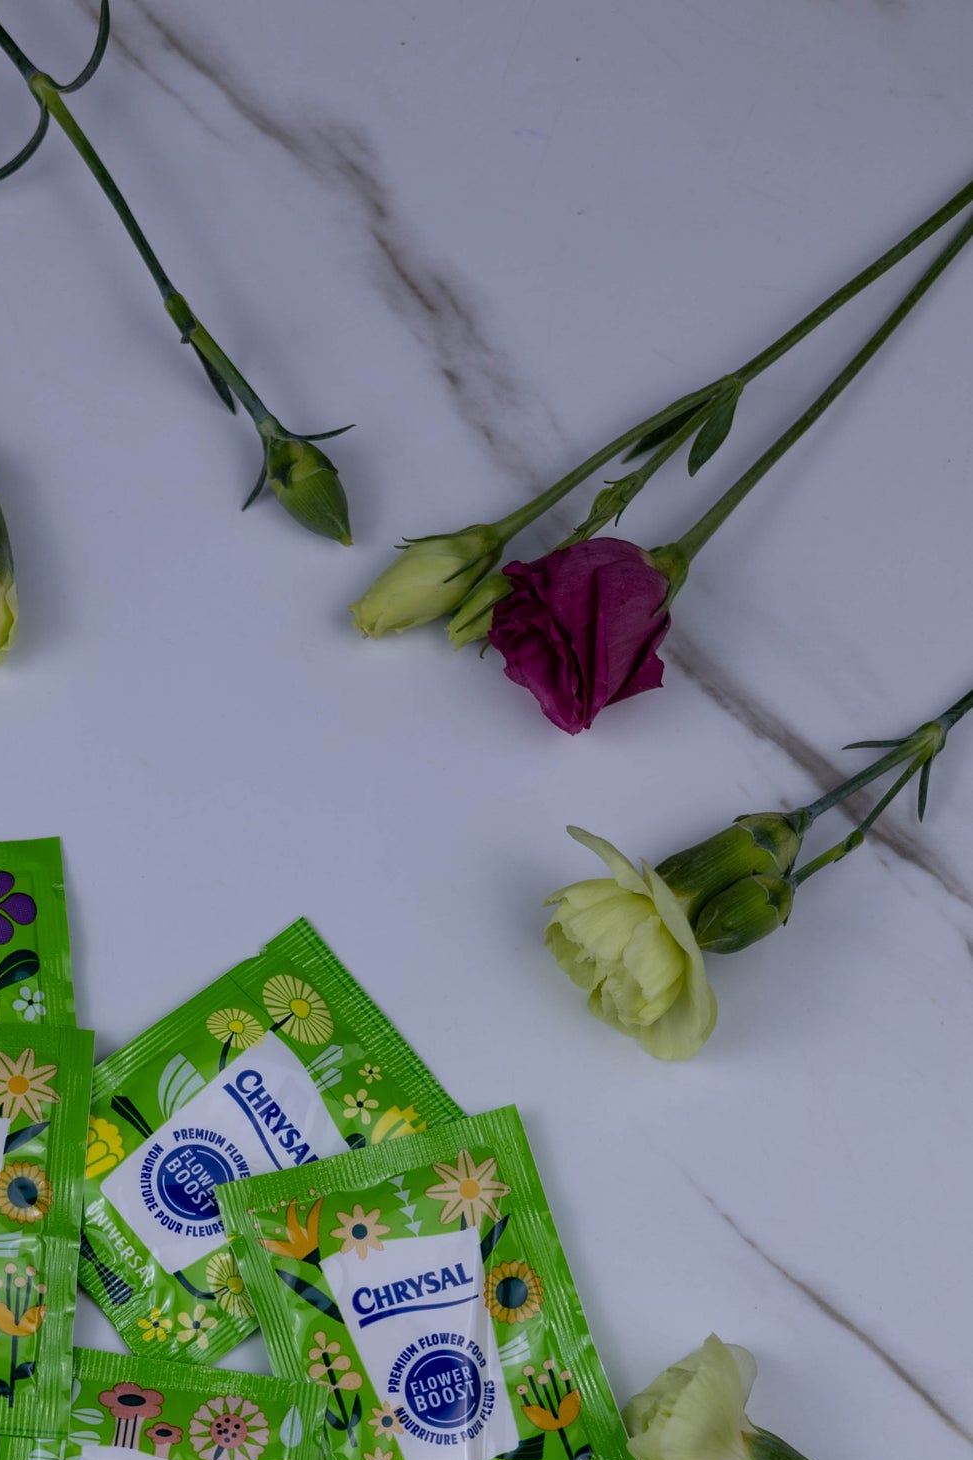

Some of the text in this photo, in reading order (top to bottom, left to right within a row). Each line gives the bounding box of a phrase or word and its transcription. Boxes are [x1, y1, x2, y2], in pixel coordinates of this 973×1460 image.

[173, 1128, 250, 1178] PREMIUM FLOWE
[179, 1149, 217, 1202] FLOWE
[140, 1143, 163, 1212] NOURRITURE
[155, 1211, 183, 1234] POUR
[165, 1157, 215, 1212] BOOST
[352, 1263, 473, 1315] CHRYSAL
[388, 1332, 487, 1393] PREMIUM FLOWER FOOD
[410, 1366, 472, 1395] FLOWER
[394, 1380, 495, 1445] NOURRITURE POUR FLEURS
[413, 1380, 475, 1412] BOOST
